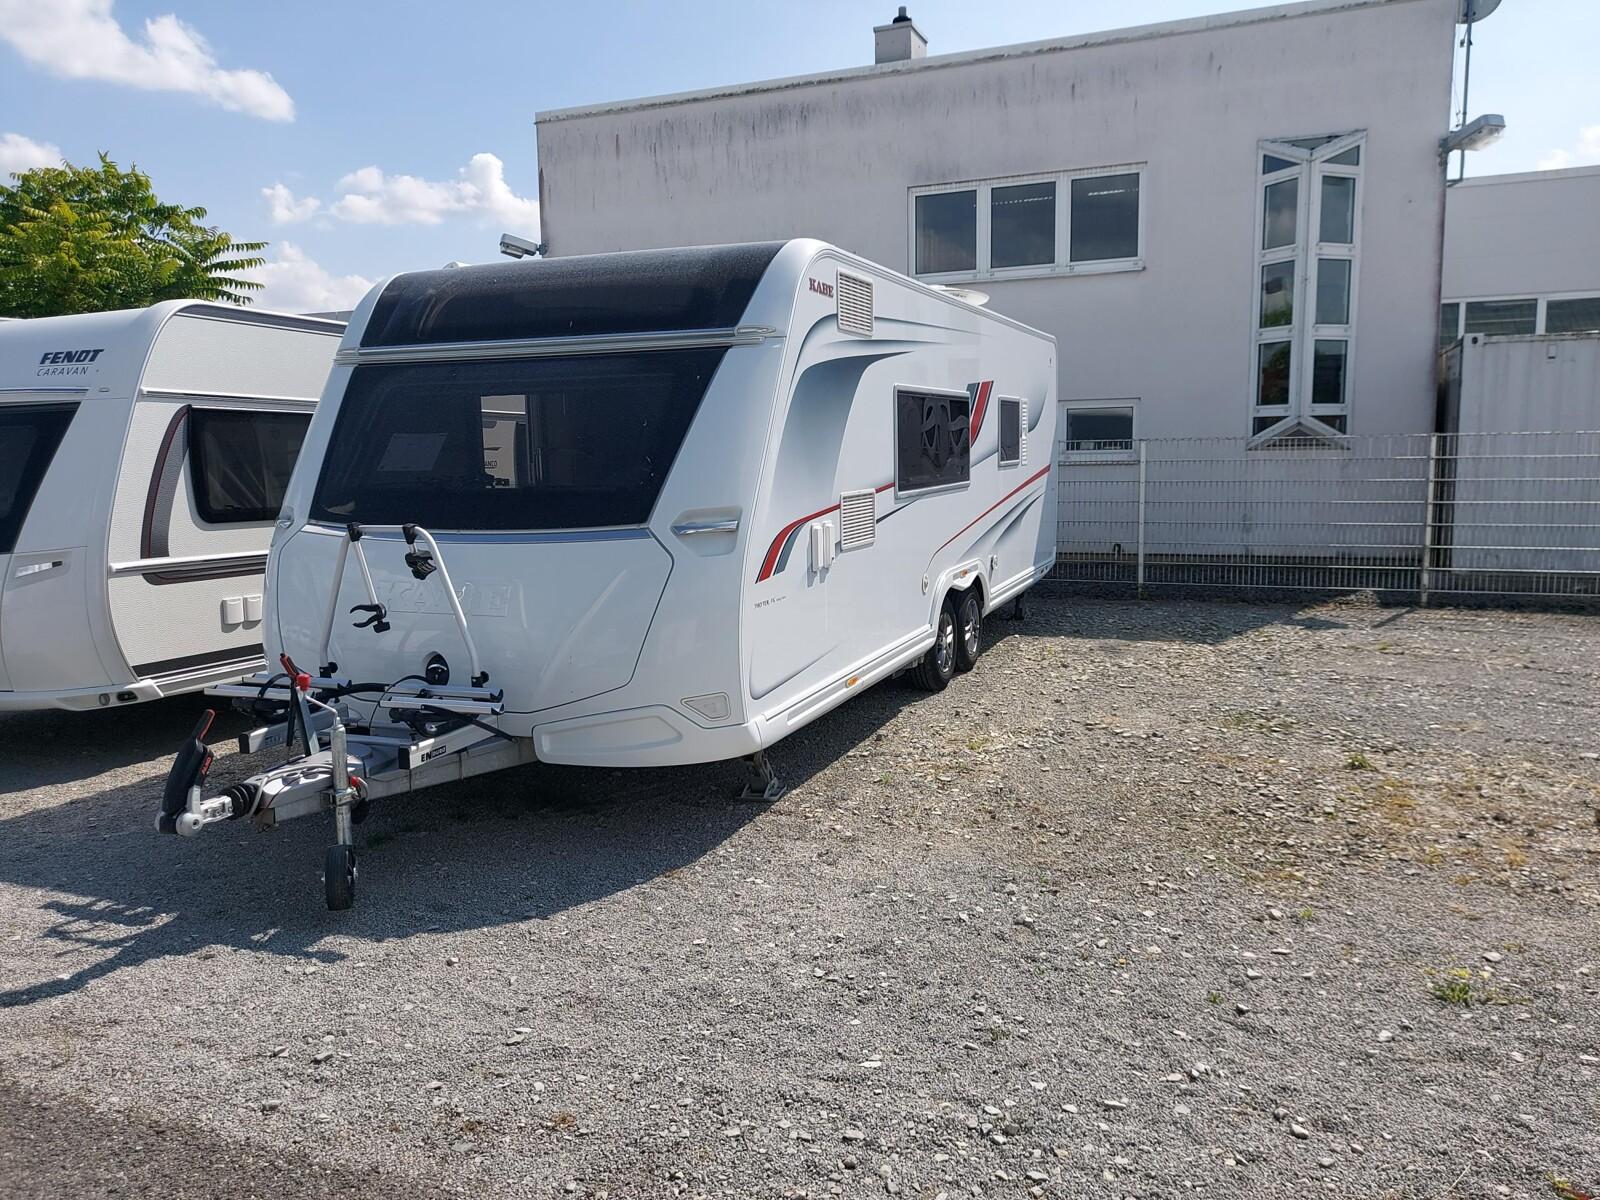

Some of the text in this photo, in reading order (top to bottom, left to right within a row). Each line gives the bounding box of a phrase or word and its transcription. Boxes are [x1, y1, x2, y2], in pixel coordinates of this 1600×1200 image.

[808, 277, 834, 298] KABE
[39, 348, 105, 365] FENDT
[36, 366, 89, 377] CARAVAN
